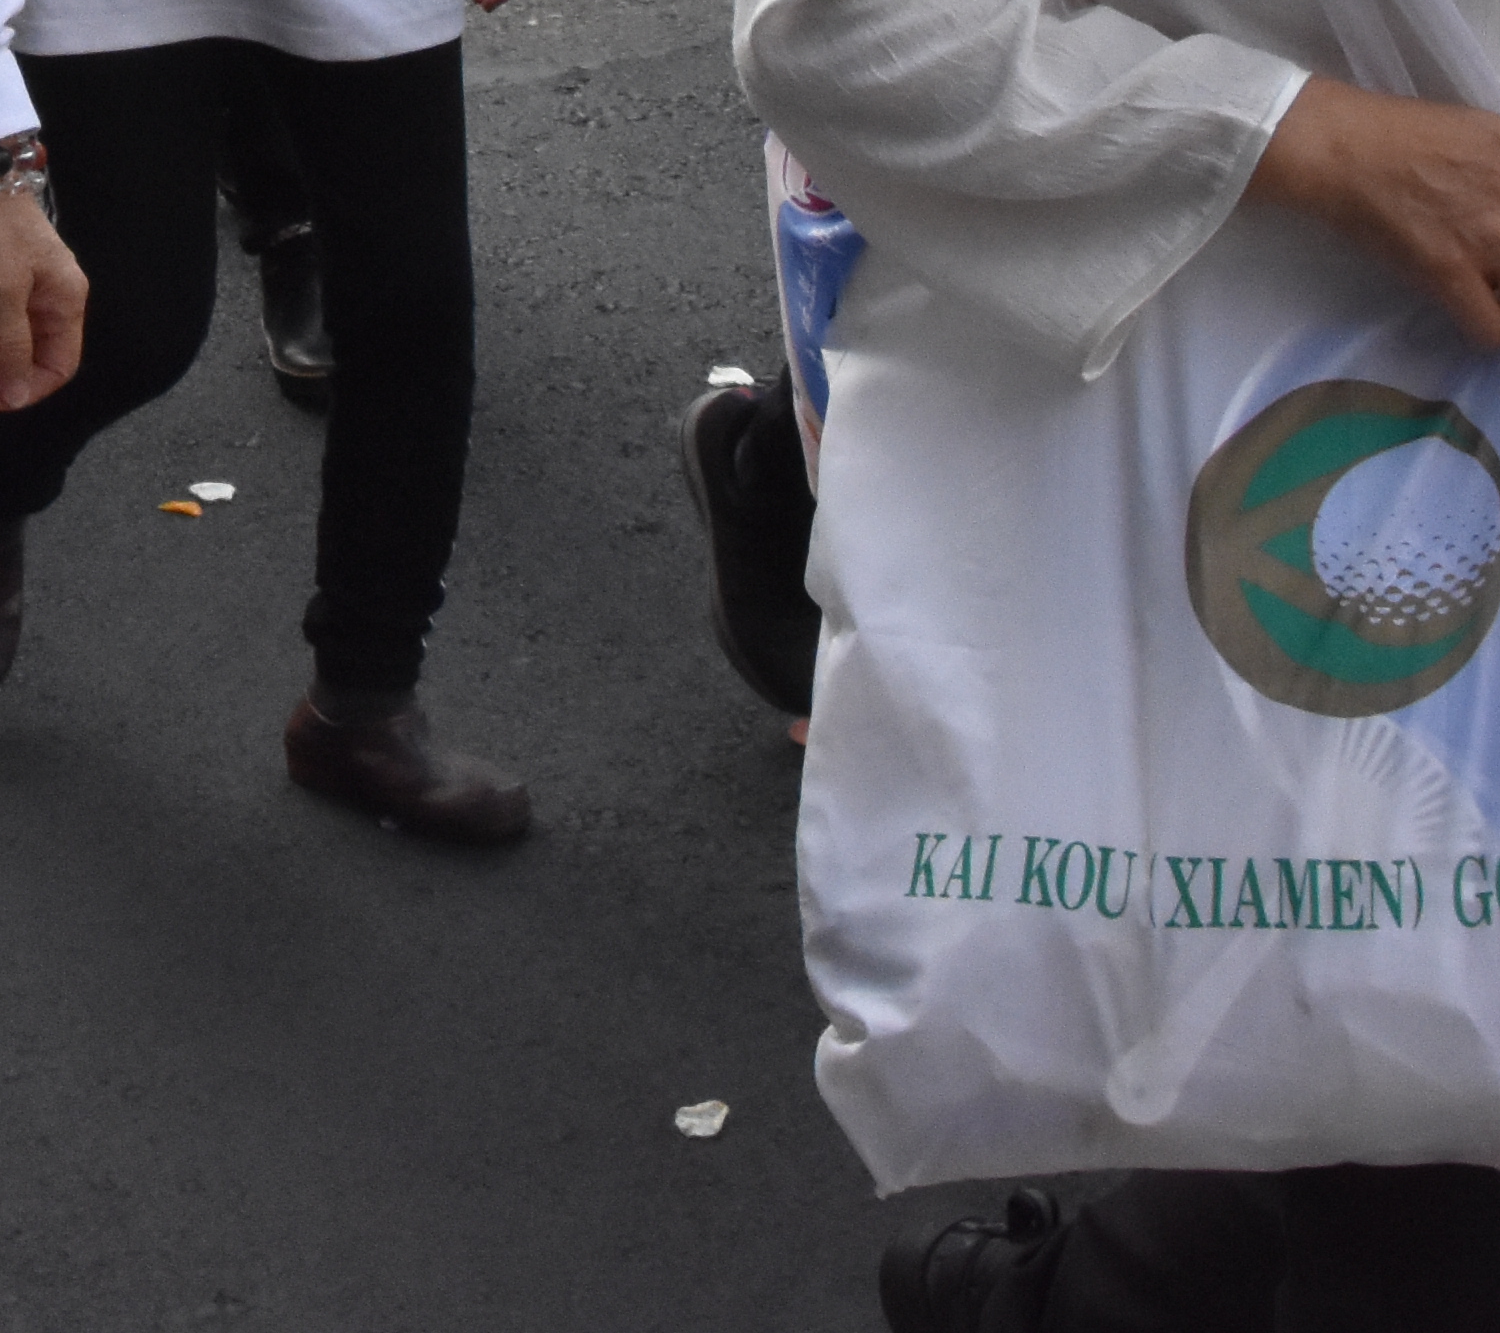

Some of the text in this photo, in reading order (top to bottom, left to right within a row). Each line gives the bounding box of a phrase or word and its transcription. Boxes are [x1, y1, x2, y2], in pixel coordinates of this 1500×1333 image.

[905, 831, 1002, 903] KAI
[1016, 835, 1135, 921] KOU
[1147, 854, 1425, 933] (XIAMEN)
